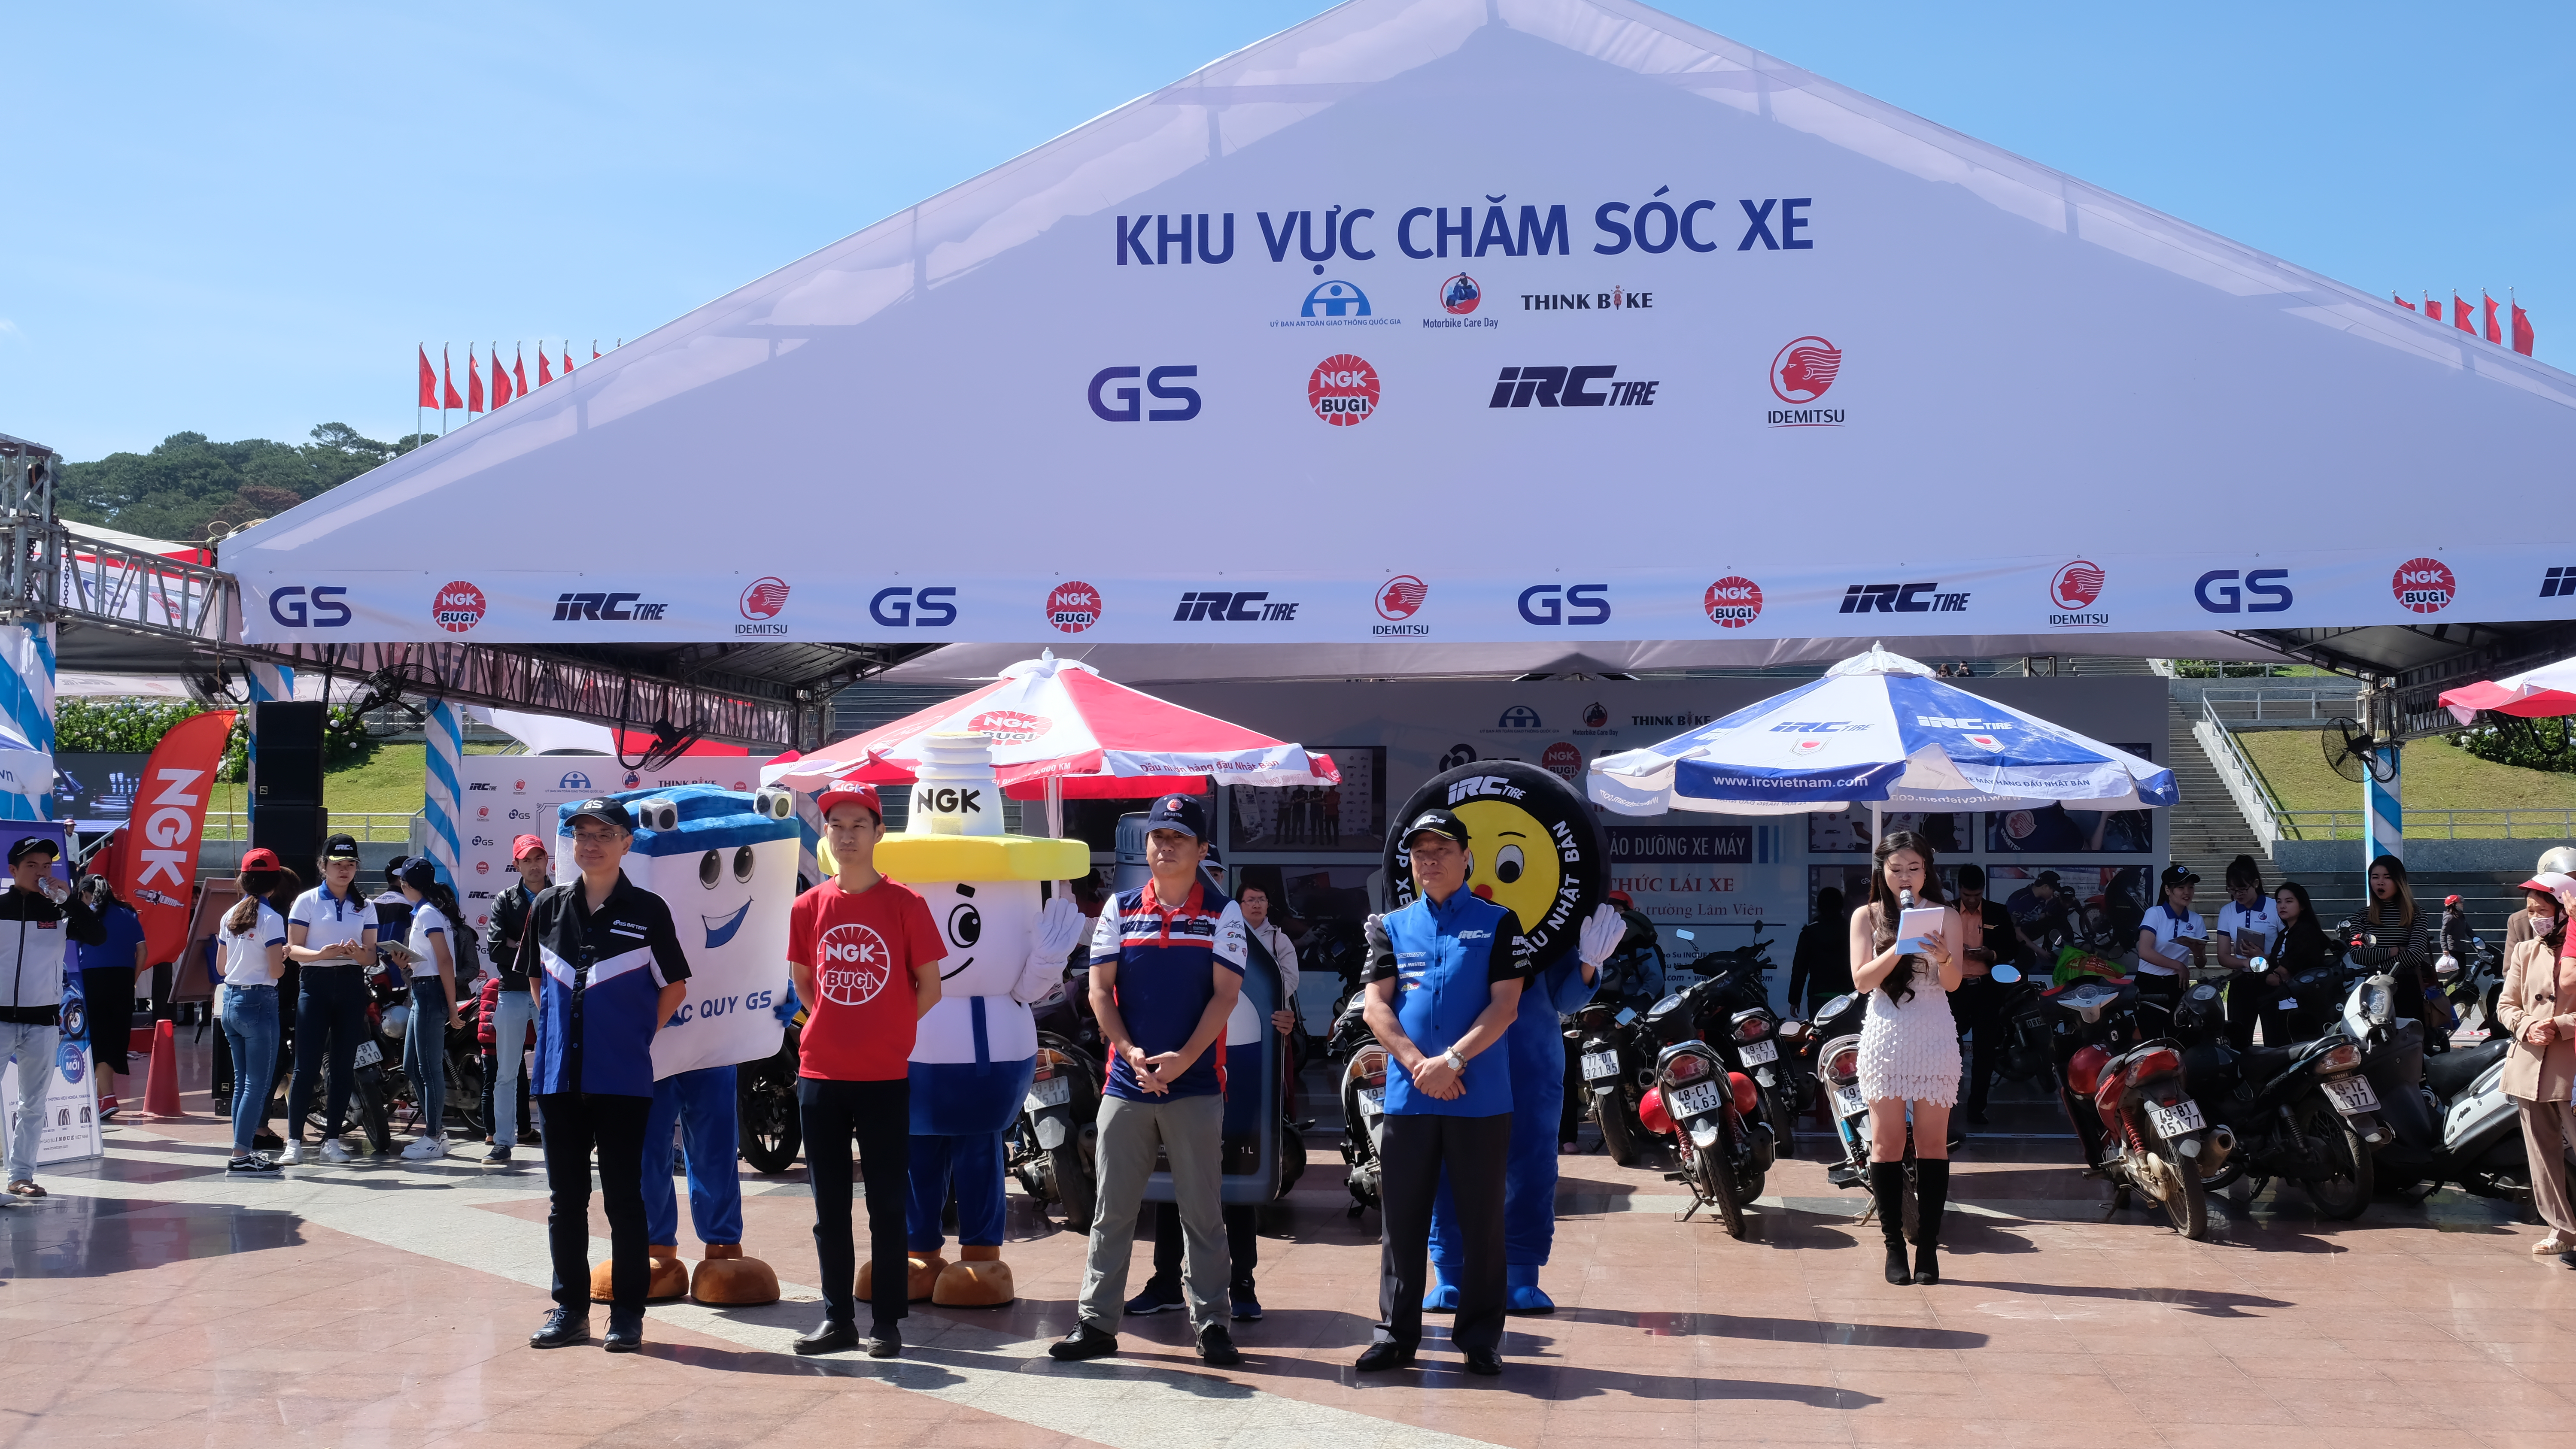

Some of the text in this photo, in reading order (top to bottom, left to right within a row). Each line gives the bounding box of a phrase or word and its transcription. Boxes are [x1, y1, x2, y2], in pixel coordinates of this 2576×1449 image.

[1116, 185, 1813, 275] KHU VỰC CHĂM SÓC XE
[1521, 294, 1591, 310] THINK
[1423, 317, 1498, 329] Motorbike Care Day
[1320, 370, 1367, 388] NGK
[1088, 365, 1201, 421] GS
[1608, 381, 1660, 406] TIRE
[1321, 396, 1368, 413] BUGI
[1761, 409, 1838, 424] IDEMITSU
[2402, 570, 2444, 584] NGK
[1714, 587, 1752, 600] NGK
[2194, 569, 2293, 613] GS
[2405, 591, 2445, 602] BUGI
[269, 586, 352, 627] GS
[442, 593, 476, 606] NGK
[869, 587, 957, 627] GS
[1055, 593, 1092, 606] NGK
[1518, 584, 1611, 625] GS
[1933, 593, 1971, 611] TIRE
[440, 611, 475, 623] BUGI
[632, 603, 668, 620] TIRE
[1055, 613, 1091, 623] BUGI
[1261, 603, 1300, 621] TIRE
[1715, 607, 1752, 619] BUGI
[2049, 613, 2109, 625] IDEMITSU
[735, 624, 788, 634] IDEMITSU
[1373, 625, 1429, 636] IDEMITSU
[984, 717, 1040, 729] NGK
[1631, 716, 1673, 726] THINK
[1549, 751, 1574, 761] NGK
[1058, 762, 1071, 770] KM
[1189, 763, 1214, 773] hàng
[835, 782, 865, 795] NGK
[1713, 776, 1868, 788] www.ircvietnam.com
[1502, 785, 1527, 800] TIRE
[583, 800, 604, 809] GS
[917, 788, 981, 814] NGK
[137, 769, 204, 886] NGK
[1610, 831, 1745, 856] ẢO DƯỠNG XE MÁY
[1547, 820, 1580, 931] NHẬT BẢN
[1669, 873, 1701, 892] LÁI
[1708, 878, 1734, 891] XE
[1647, 903, 1763, 919] trường Lâm Viên
[825, 943, 875, 963] NGK
[825, 970, 873, 990] BUGI
[701, 990, 772, 1019] QUY GS
[2028, 1019, 2041, 1027] 086
[1745, 1042, 1769, 1055] 49-E1
[66, 1058, 80, 1070] MỚI
[1586, 1052, 1612, 1067] 77-D1
[1746, 1050, 1776, 1065] 408.73
[1585, 1063, 1617, 1079] 321.85
[1678, 1084, 1709, 1102] 48-C1
[1677, 1095, 1717, 1116] 154.63
[2159, 1103, 2192, 1124] 49-B1
[1248, 1146, 1254, 1155] L
